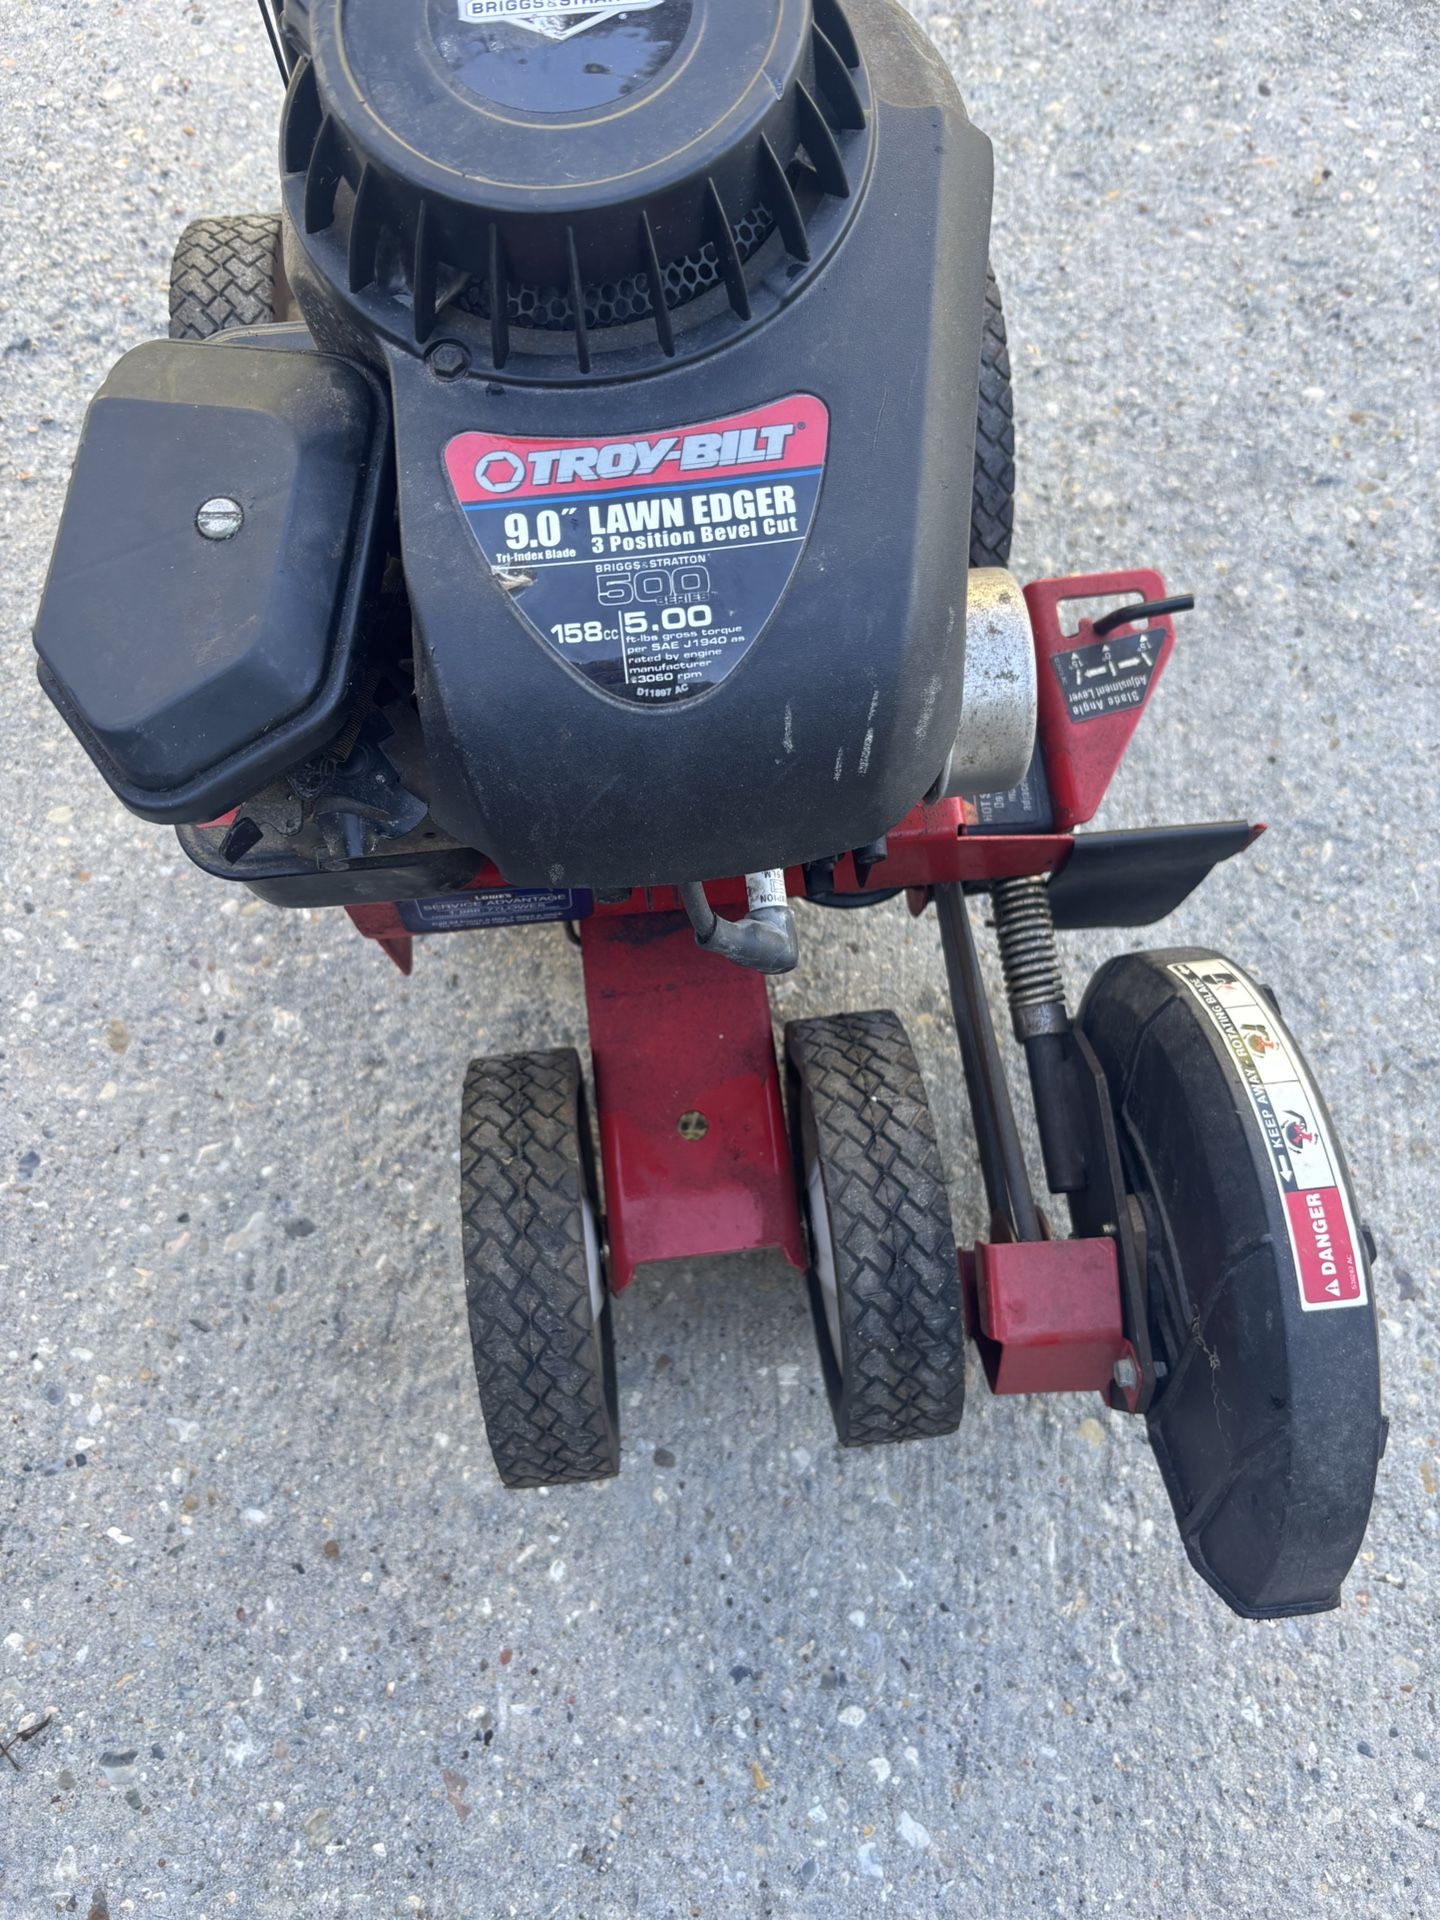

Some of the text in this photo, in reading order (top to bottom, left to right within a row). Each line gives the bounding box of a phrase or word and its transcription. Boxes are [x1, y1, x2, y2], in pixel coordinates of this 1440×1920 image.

[528, 423, 795, 486] TROY-BILT
[588, 496, 687, 535] LAWN
[692, 485, 797, 525] EDGER
[591, 516, 799, 554] 3 Position Bevel Cut
[496, 548, 577, 564] Tri-Index Blade
[596, 565, 711, 606] 500
[624, 604, 713, 634] 5.00
[625, 626, 743, 644] ft-lbs gross torque
[627, 646, 648, 655] per
[651, 641, 680, 651] SAE
[683, 635, 728, 648] J1940
[628, 648, 722, 664] rated by engine
[629, 660, 712, 674] manufacturer
[675, 683, 689, 694] AC
[677, 671, 702, 681] rpm
[1069, 674, 1147, 703] Adjustment Lever
[1072, 690, 1140, 715] Blade Angle
[487, 894, 566, 906] ADVANTAGE
[1190, 977, 1216, 1004] BLADE
[1211, 1005, 1247, 1058] ROTATING
[1244, 1069, 1271, 1105] AWAY
[1262, 1112, 1285, 1149] KEEP
[1306, 1193, 1337, 1276] DANGER
